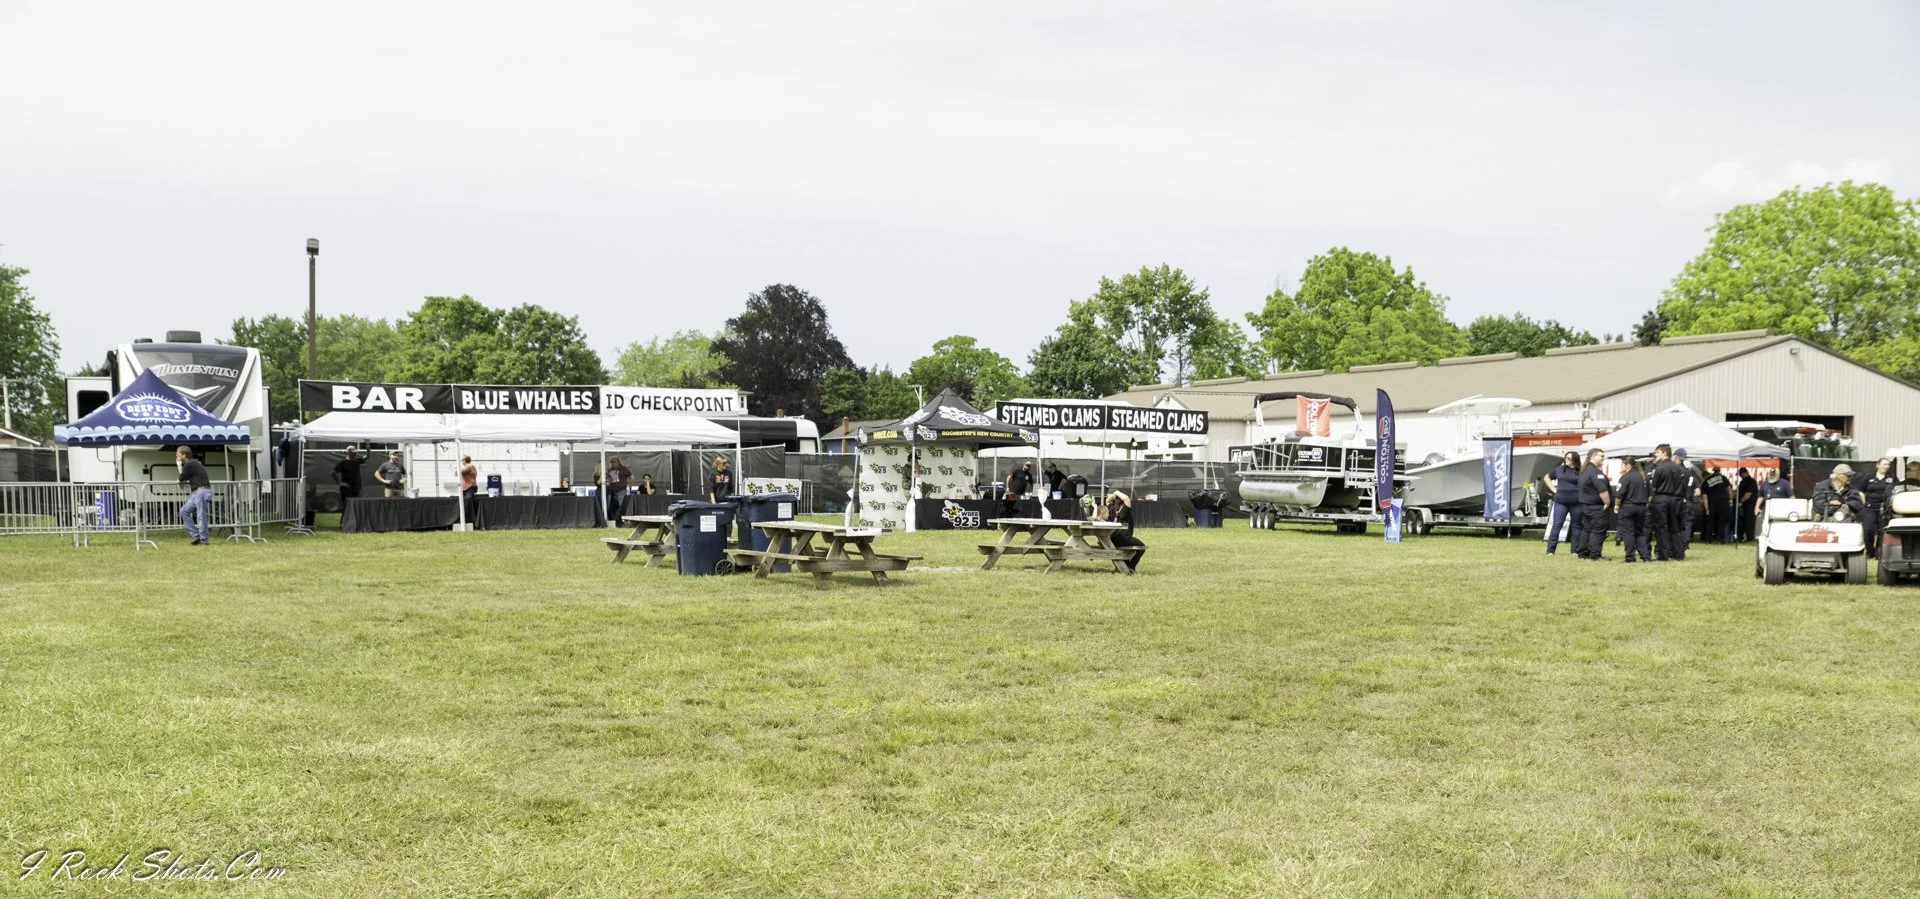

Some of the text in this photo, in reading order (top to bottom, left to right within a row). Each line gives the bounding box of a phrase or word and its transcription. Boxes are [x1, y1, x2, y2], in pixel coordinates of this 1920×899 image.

[331, 385, 426, 411] BAR
[461, 390, 593, 410] BLUE WHALES
[606, 394, 733, 412] ID CHECKPOINT
[127, 404, 182, 415] DEEP EDDY
[1001, 405, 1100, 427] STEAMED CLAMS
[1112, 408, 1204, 432] STEAMED CLAMS
[1380, 439, 1388, 484] COLTON
